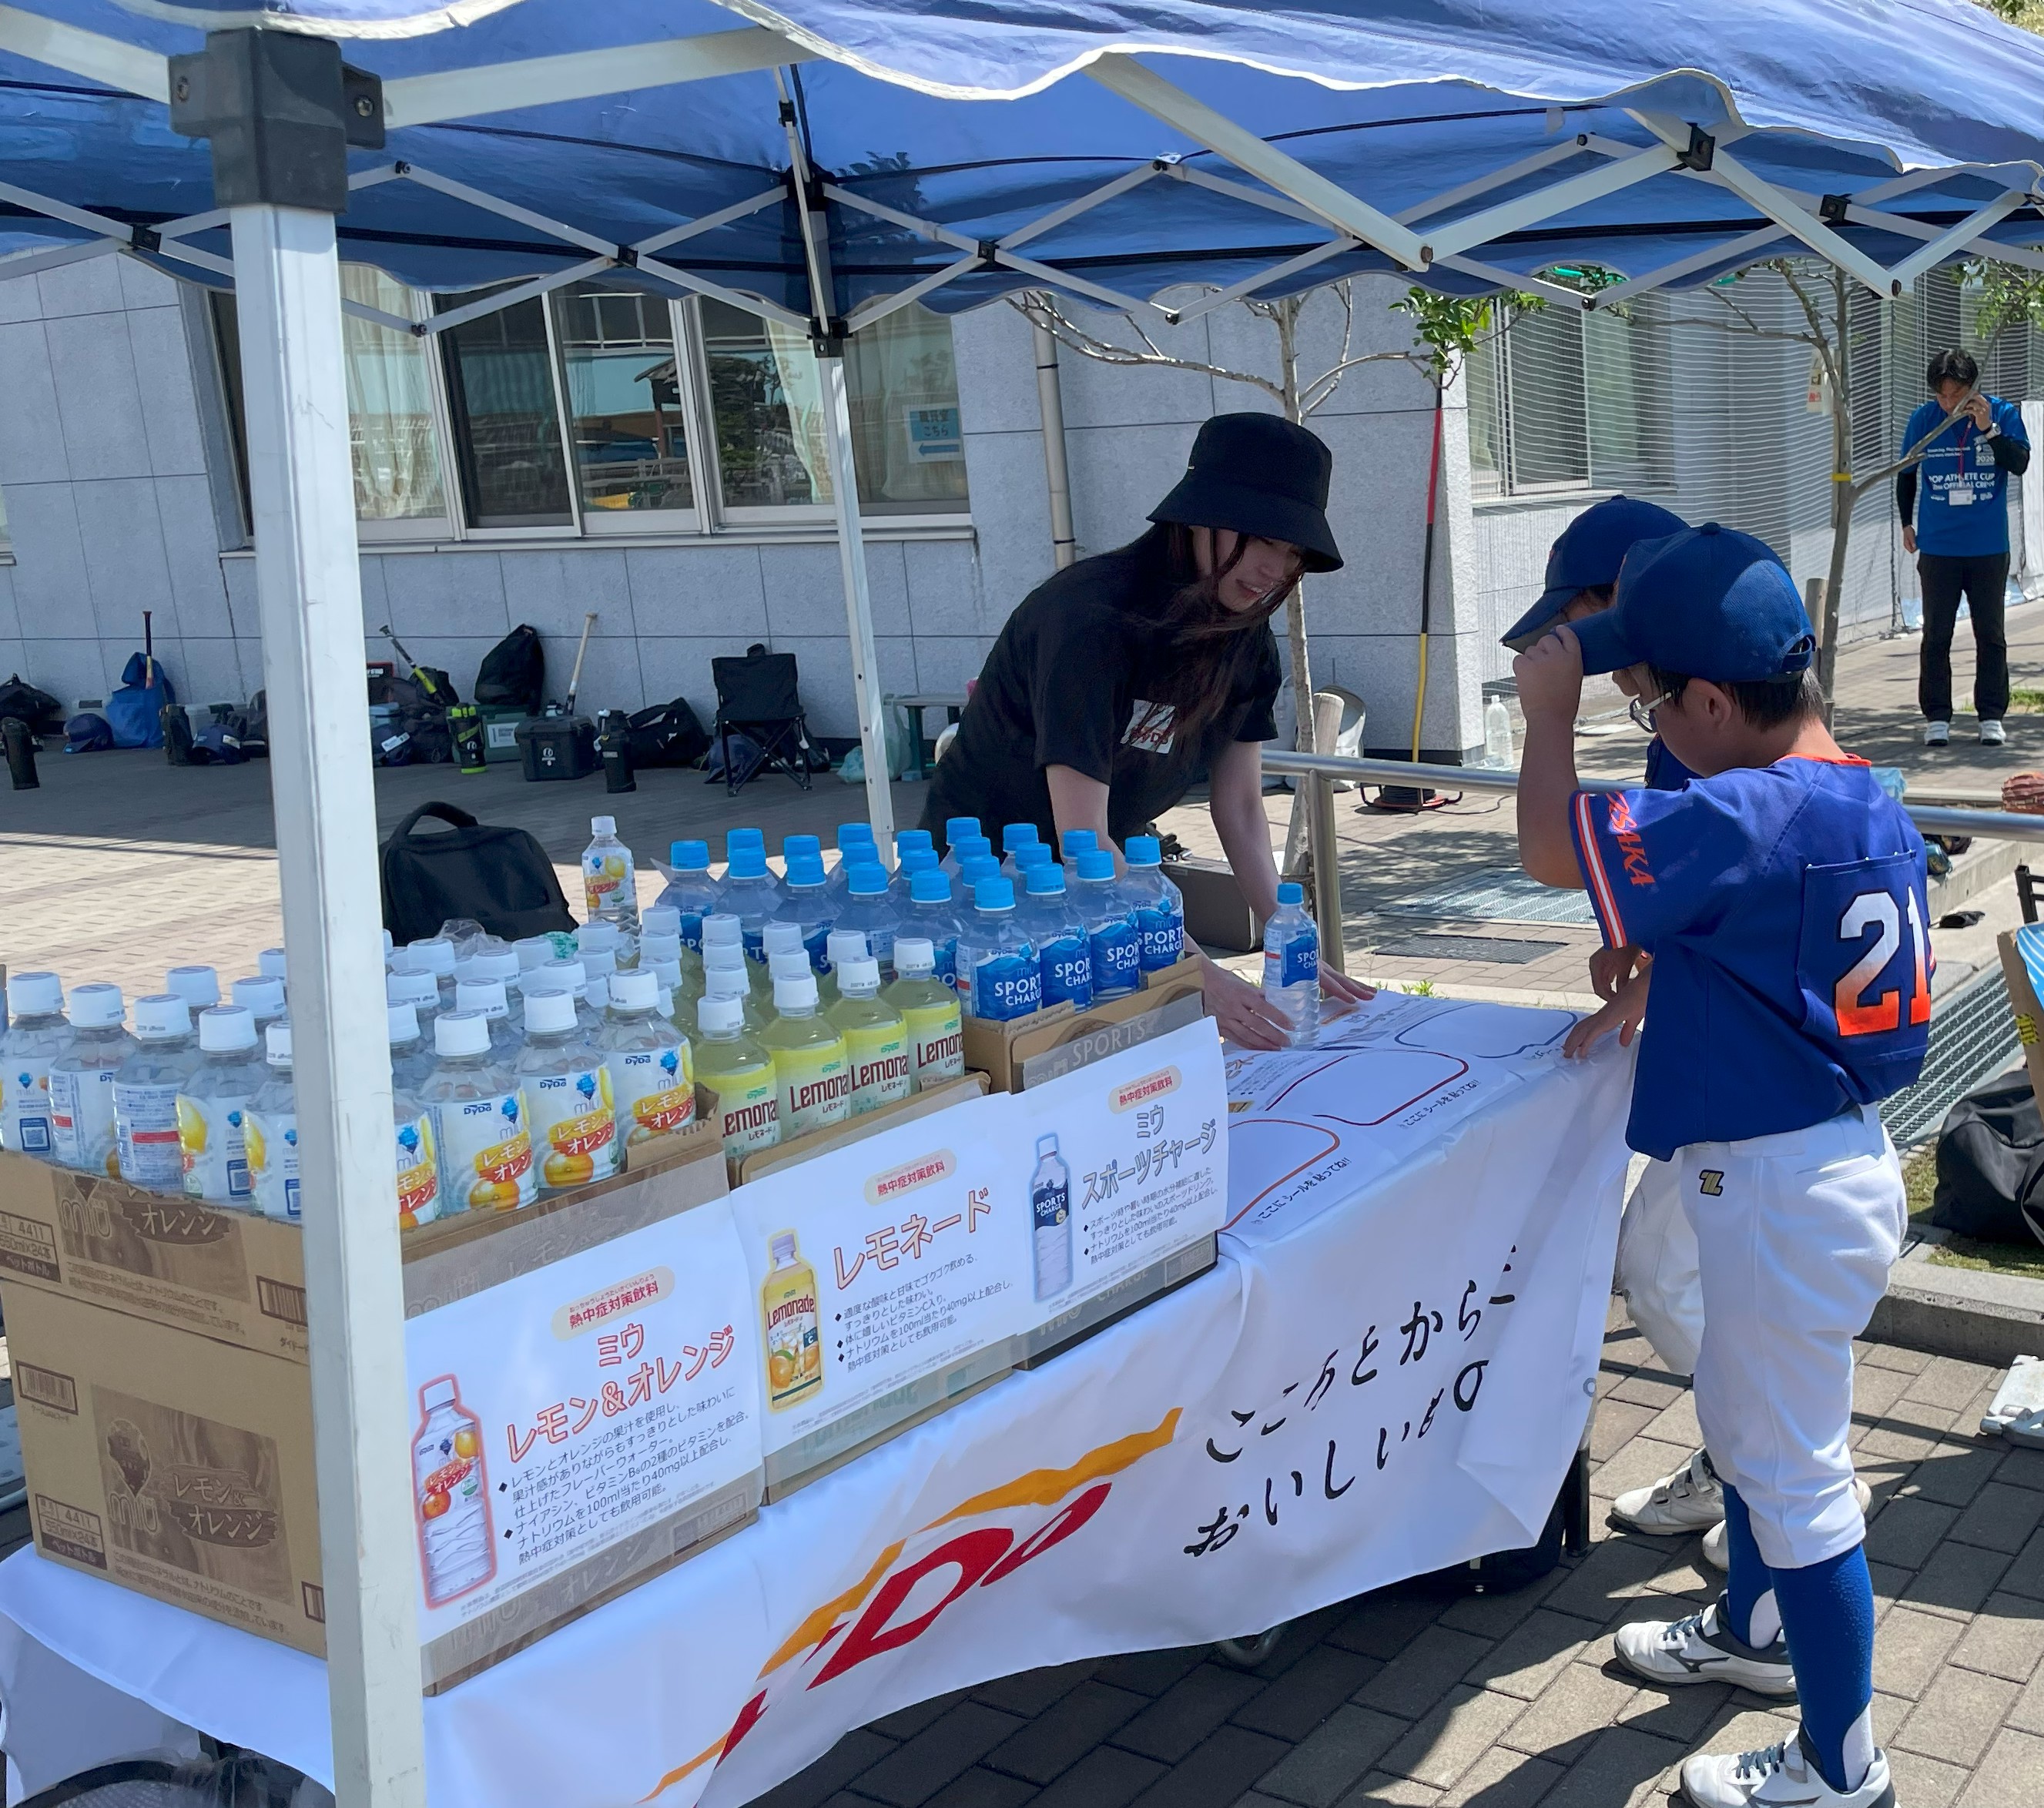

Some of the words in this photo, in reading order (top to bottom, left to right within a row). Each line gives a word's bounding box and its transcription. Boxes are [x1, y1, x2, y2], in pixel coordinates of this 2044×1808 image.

[924, 426, 948, 437] こちら
[1138, 926, 1185, 946] SPORT
[1835, 885, 1932, 1036] 21
[1073, 1017, 1147, 1067] SPORTS
[625, 1055, 651, 1066] DyDo
[540, 1078, 567, 1090] DyDo
[464, 1103, 491, 1116] DyDo
[722, 1099, 780, 1138] emona
[1136, 1104, 1164, 1139] ミウ
[877, 1160, 946, 1197] 熱中症対策飲料
[1081, 1118, 1217, 1210] スポーツチャージ
[1036, 1192, 1065, 1214] SPORTS
[18, 1221, 44, 1241] 4411
[833, 1187, 991, 1290] レモネード
[568, 1280, 658, 1330] 熱中症対策飲料
[767, 1294, 815, 1330] Lemonade
[598, 1323, 645, 1367] ミウ
[506, 1324, 736, 1465] レモン&オレンジ
[189, 1504, 263, 1540] オレンジ
